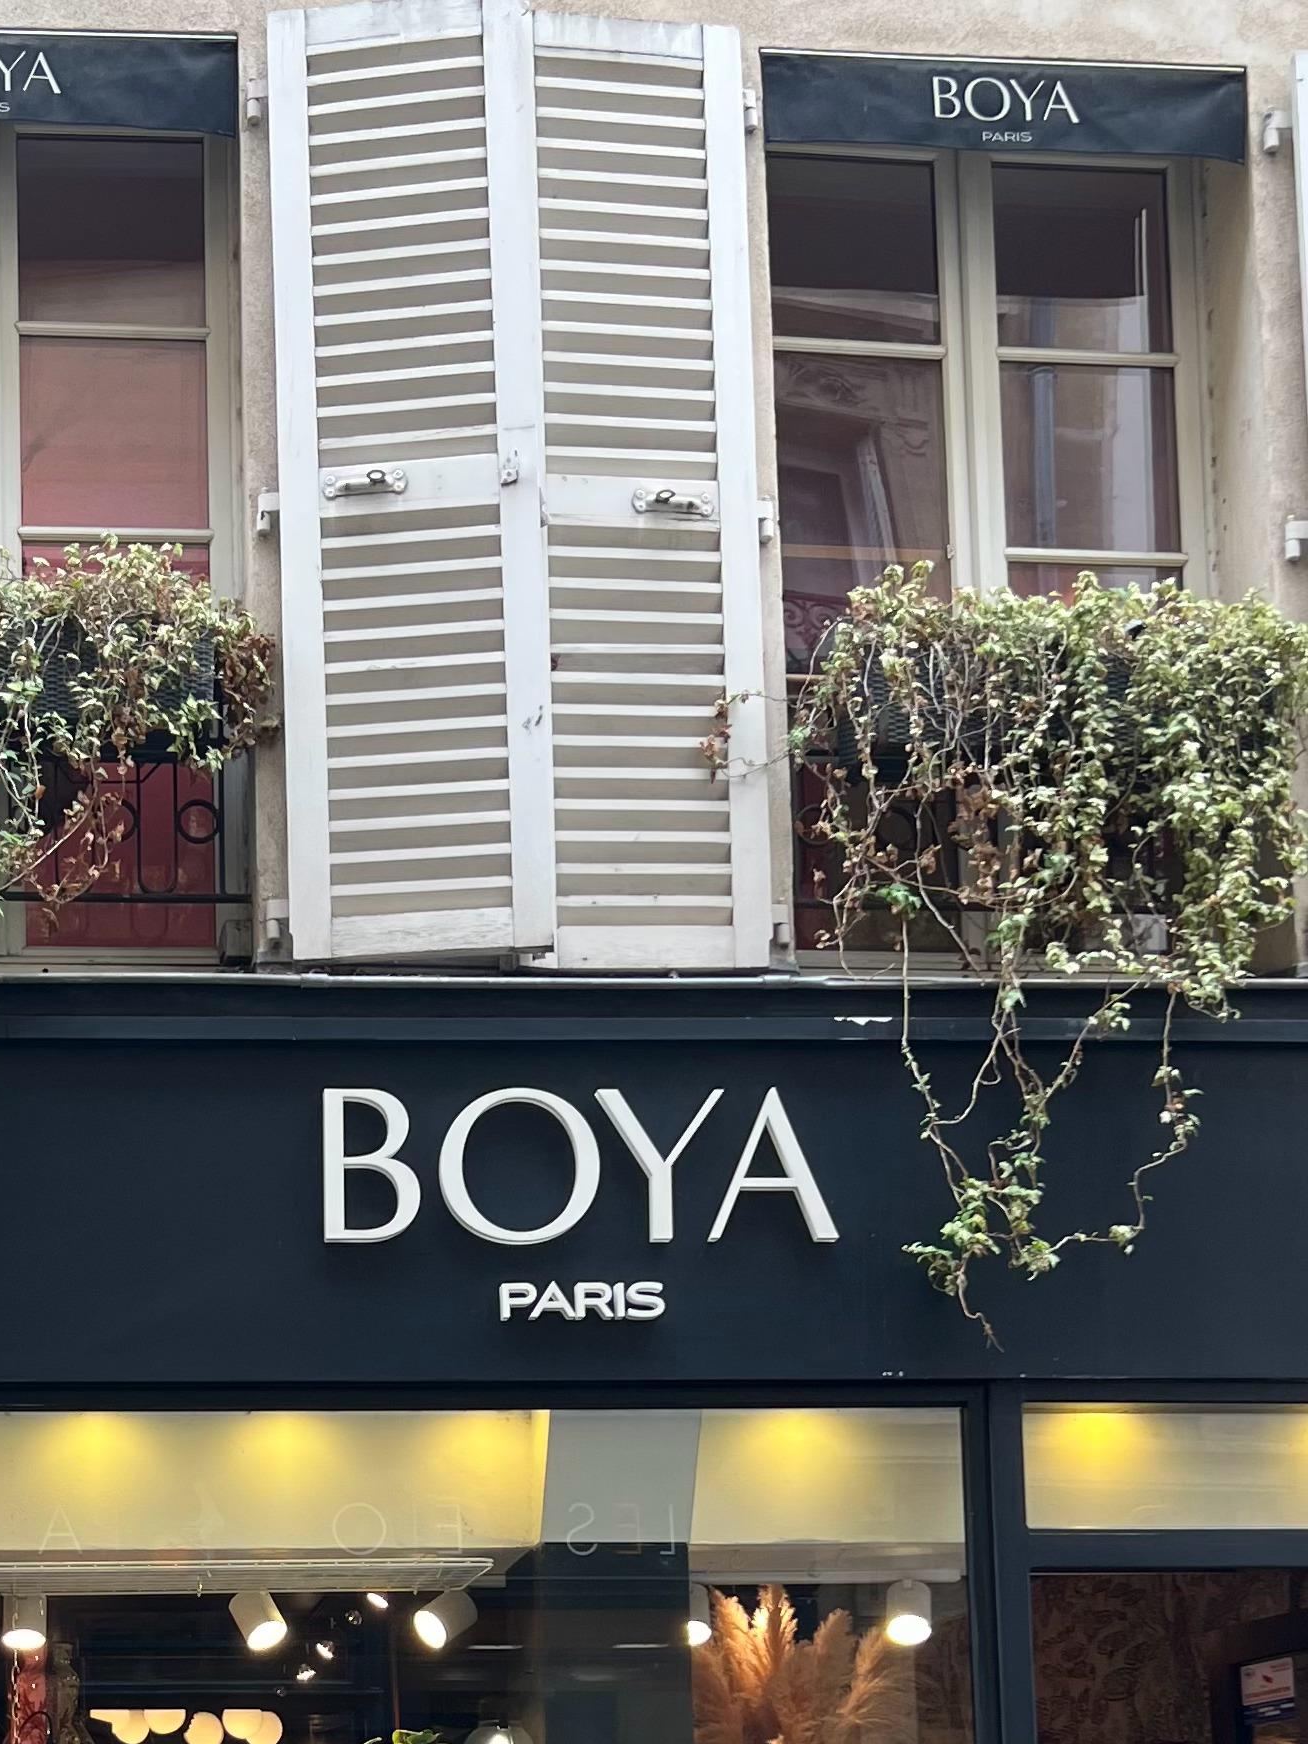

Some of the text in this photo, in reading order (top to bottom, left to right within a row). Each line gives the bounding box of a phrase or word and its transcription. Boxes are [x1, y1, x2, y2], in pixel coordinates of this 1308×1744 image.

[932, 75, 1080, 124] BOYA
[981, 131, 1033, 143] PARIS
[322, 1086, 840, 1246] BOYA
[498, 1280, 667, 1322] PARIS
